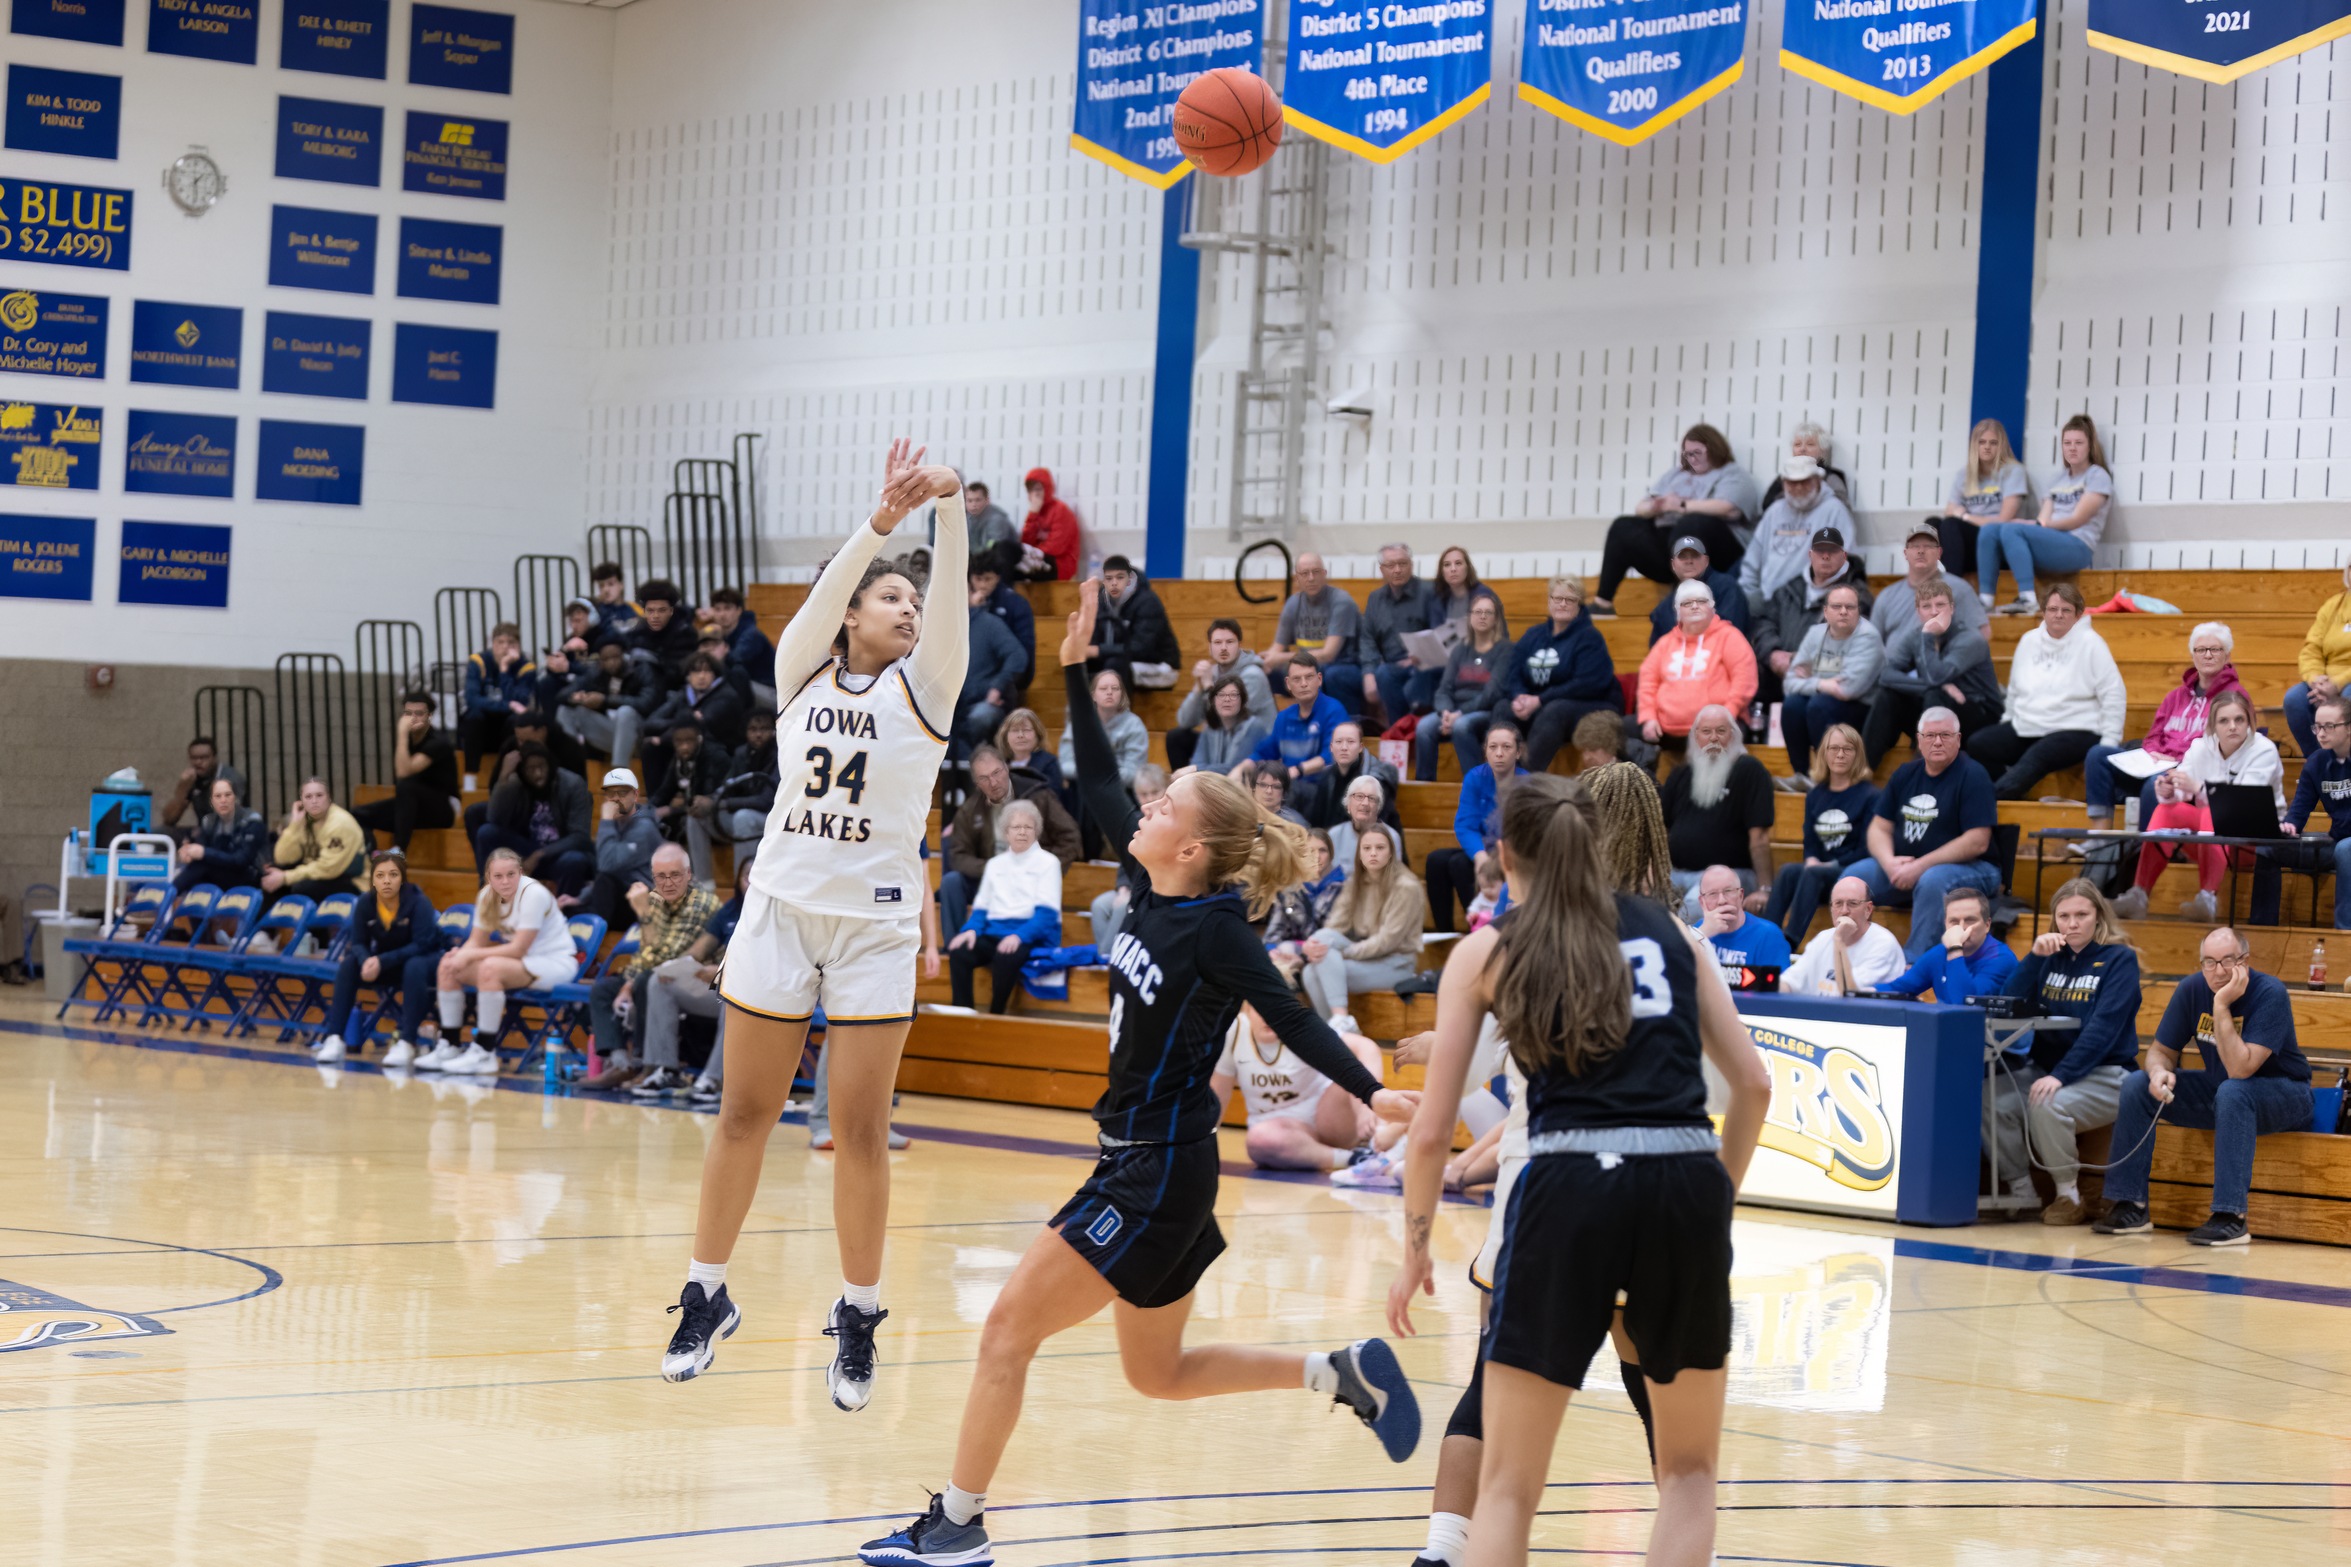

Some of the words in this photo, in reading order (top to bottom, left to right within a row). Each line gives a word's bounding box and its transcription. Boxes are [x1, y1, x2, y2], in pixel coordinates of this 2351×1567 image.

[1086, 13, 1138, 38] Region
[1143, 7, 1164, 29] XI
[1165, 0, 1257, 24] Champions
[1300, 12, 1362, 38] District
[1366, 8, 1380, 30] 5
[1382, 0, 1486, 28] Champions
[1538, 19, 1617, 47] National
[1621, 2, 1742, 40] Tournament
[1814, 0, 1891, 21] National
[2203, 10, 2251, 33] 2021
[179, 17, 229, 34] LARSON
[1862, 22, 1951, 52] Qualifiers
[1087, 45, 1143, 68] District
[1147, 41, 1161, 61] 6
[1162, 29, 1253, 58] Champions
[1298, 43, 1373, 72] National
[1375, 30, 1484, 63] Tournament
[1586, 50, 1682, 83] Qualifiers
[1882, 54, 1931, 81] 2013
[1087, 74, 1153, 101] National
[1344, 77, 1378, 101] 4th
[1379, 75, 1428, 97] Place
[1607, 86, 1658, 114] 2000
[26, 93, 51, 107] KIM
[66, 97, 102, 113] TODD
[1124, 103, 1160, 129] 2nd
[1364, 107, 1408, 134] 1994
[1146, 136, 1184, 159] 199
[20, 185, 126, 233] BLUE
[19, 226, 113, 264] $2,499)
[3, 335, 23, 353] Dr.
[25, 337, 60, 358] Cory
[61, 341, 88, 356] and
[0, 354, 53, 373] Michelle
[56, 357, 97, 377] Hoyer
[805, 706, 878, 740] IOWA
[804, 745, 869, 806] 34
[782, 807, 872, 843] LAKES
[1754, 1029, 1816, 1059] COLLEGE
[1251, 1072, 1294, 1088] IOWA
